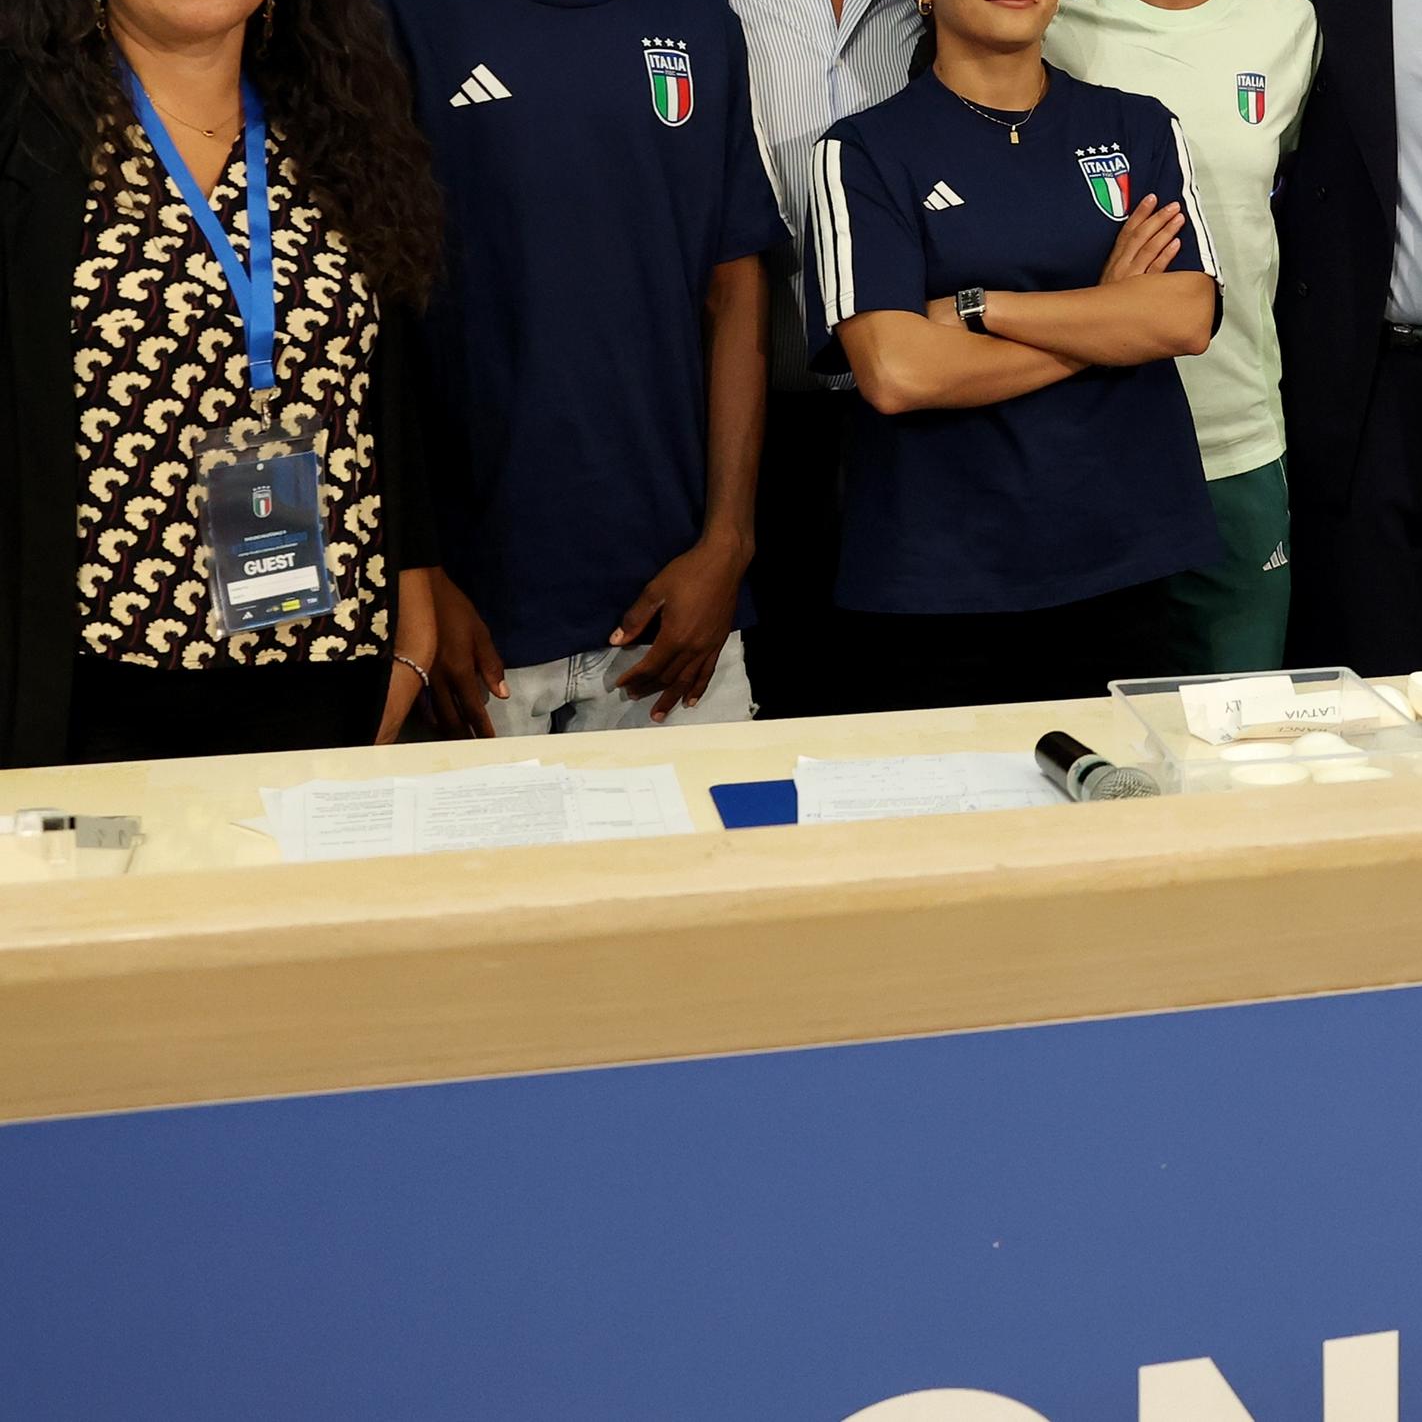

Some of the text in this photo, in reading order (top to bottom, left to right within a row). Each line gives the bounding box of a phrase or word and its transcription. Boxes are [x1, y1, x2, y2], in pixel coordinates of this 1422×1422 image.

[648, 54, 687, 72] ITALIA
[1237, 75, 1265, 88] ITALIA
[1083, 157, 1126, 174] ITALIA
[243, 552, 296, 576] GUEST
[1285, 706, 1336, 720] LATVIA
